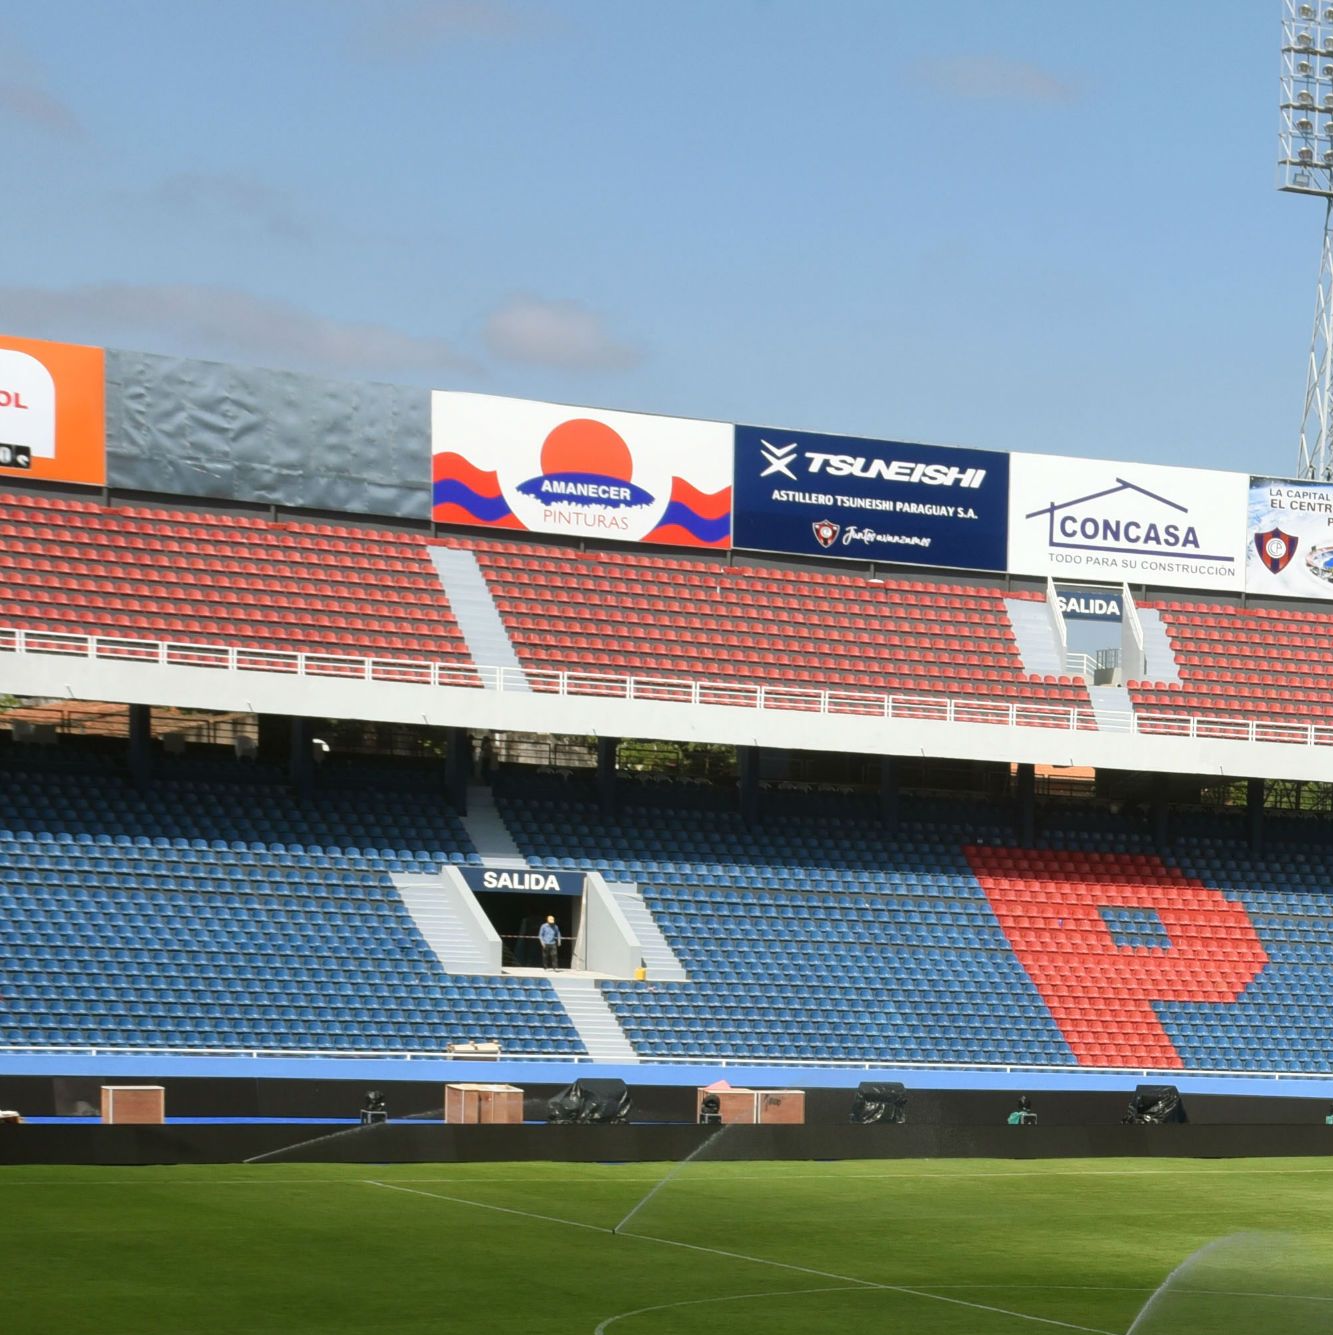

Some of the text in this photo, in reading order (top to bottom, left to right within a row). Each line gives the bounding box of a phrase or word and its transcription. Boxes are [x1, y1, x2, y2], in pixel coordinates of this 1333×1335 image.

[805, 452, 987, 489] TSUNEISHI
[541, 480, 632, 501] AMANECER
[1269, 488, 1283, 498] LA
[1286, 490, 1331, 502] CAPITAL
[772, 489, 979, 520] ASTILLERO TSUNEISHI PARAGUAY S.A.
[1270, 499, 1285, 510] EL
[543, 509, 629, 530] PINTURAS
[1060, 515, 1201, 549] CONCASA
[1048, 553, 1236, 577] TODO PARA SU CONSTRUCCIÓN
[1055, 597, 1121, 616] SALIDA
[483, 871, 561, 891] SALIDA
